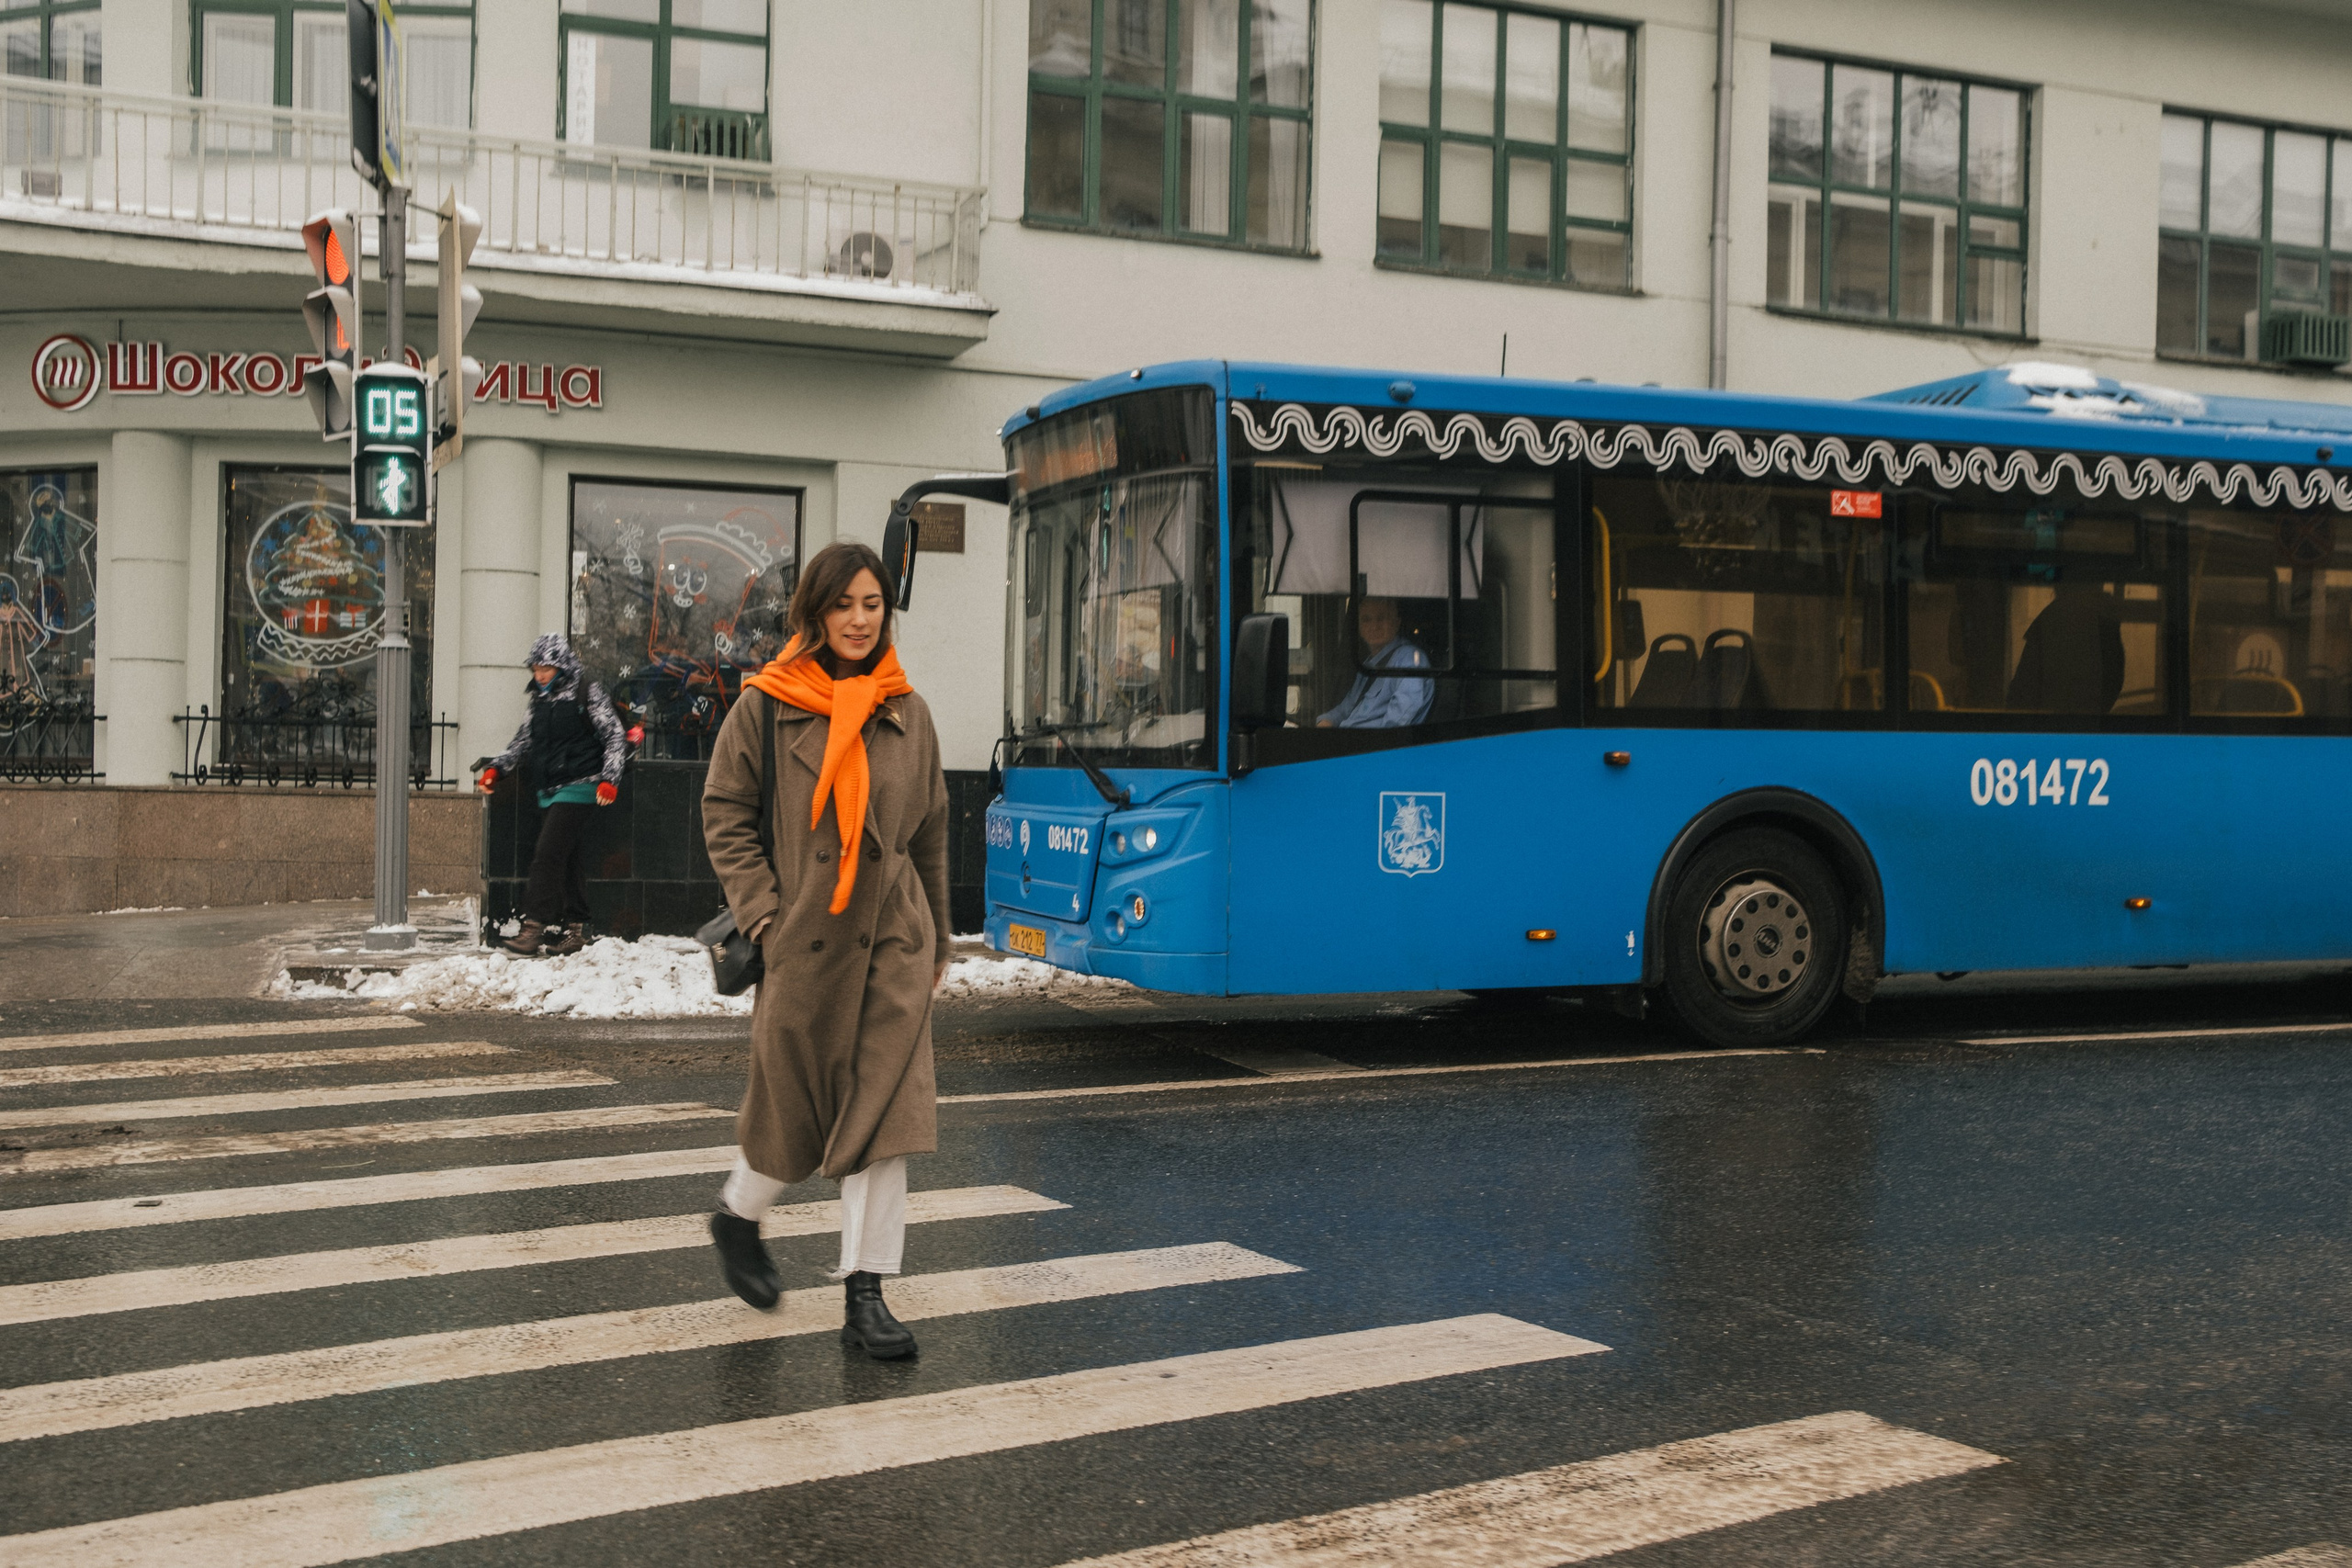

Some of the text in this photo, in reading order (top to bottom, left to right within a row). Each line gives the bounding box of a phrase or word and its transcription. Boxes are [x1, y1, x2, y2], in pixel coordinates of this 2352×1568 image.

[106, 341, 603, 413] Шоколица
[368, 388, 418, 434] 05
[1970, 758, 2110, 807] 081472
[1047, 824, 1090, 854] 081472
[1071, 893, 1080, 912] 4
